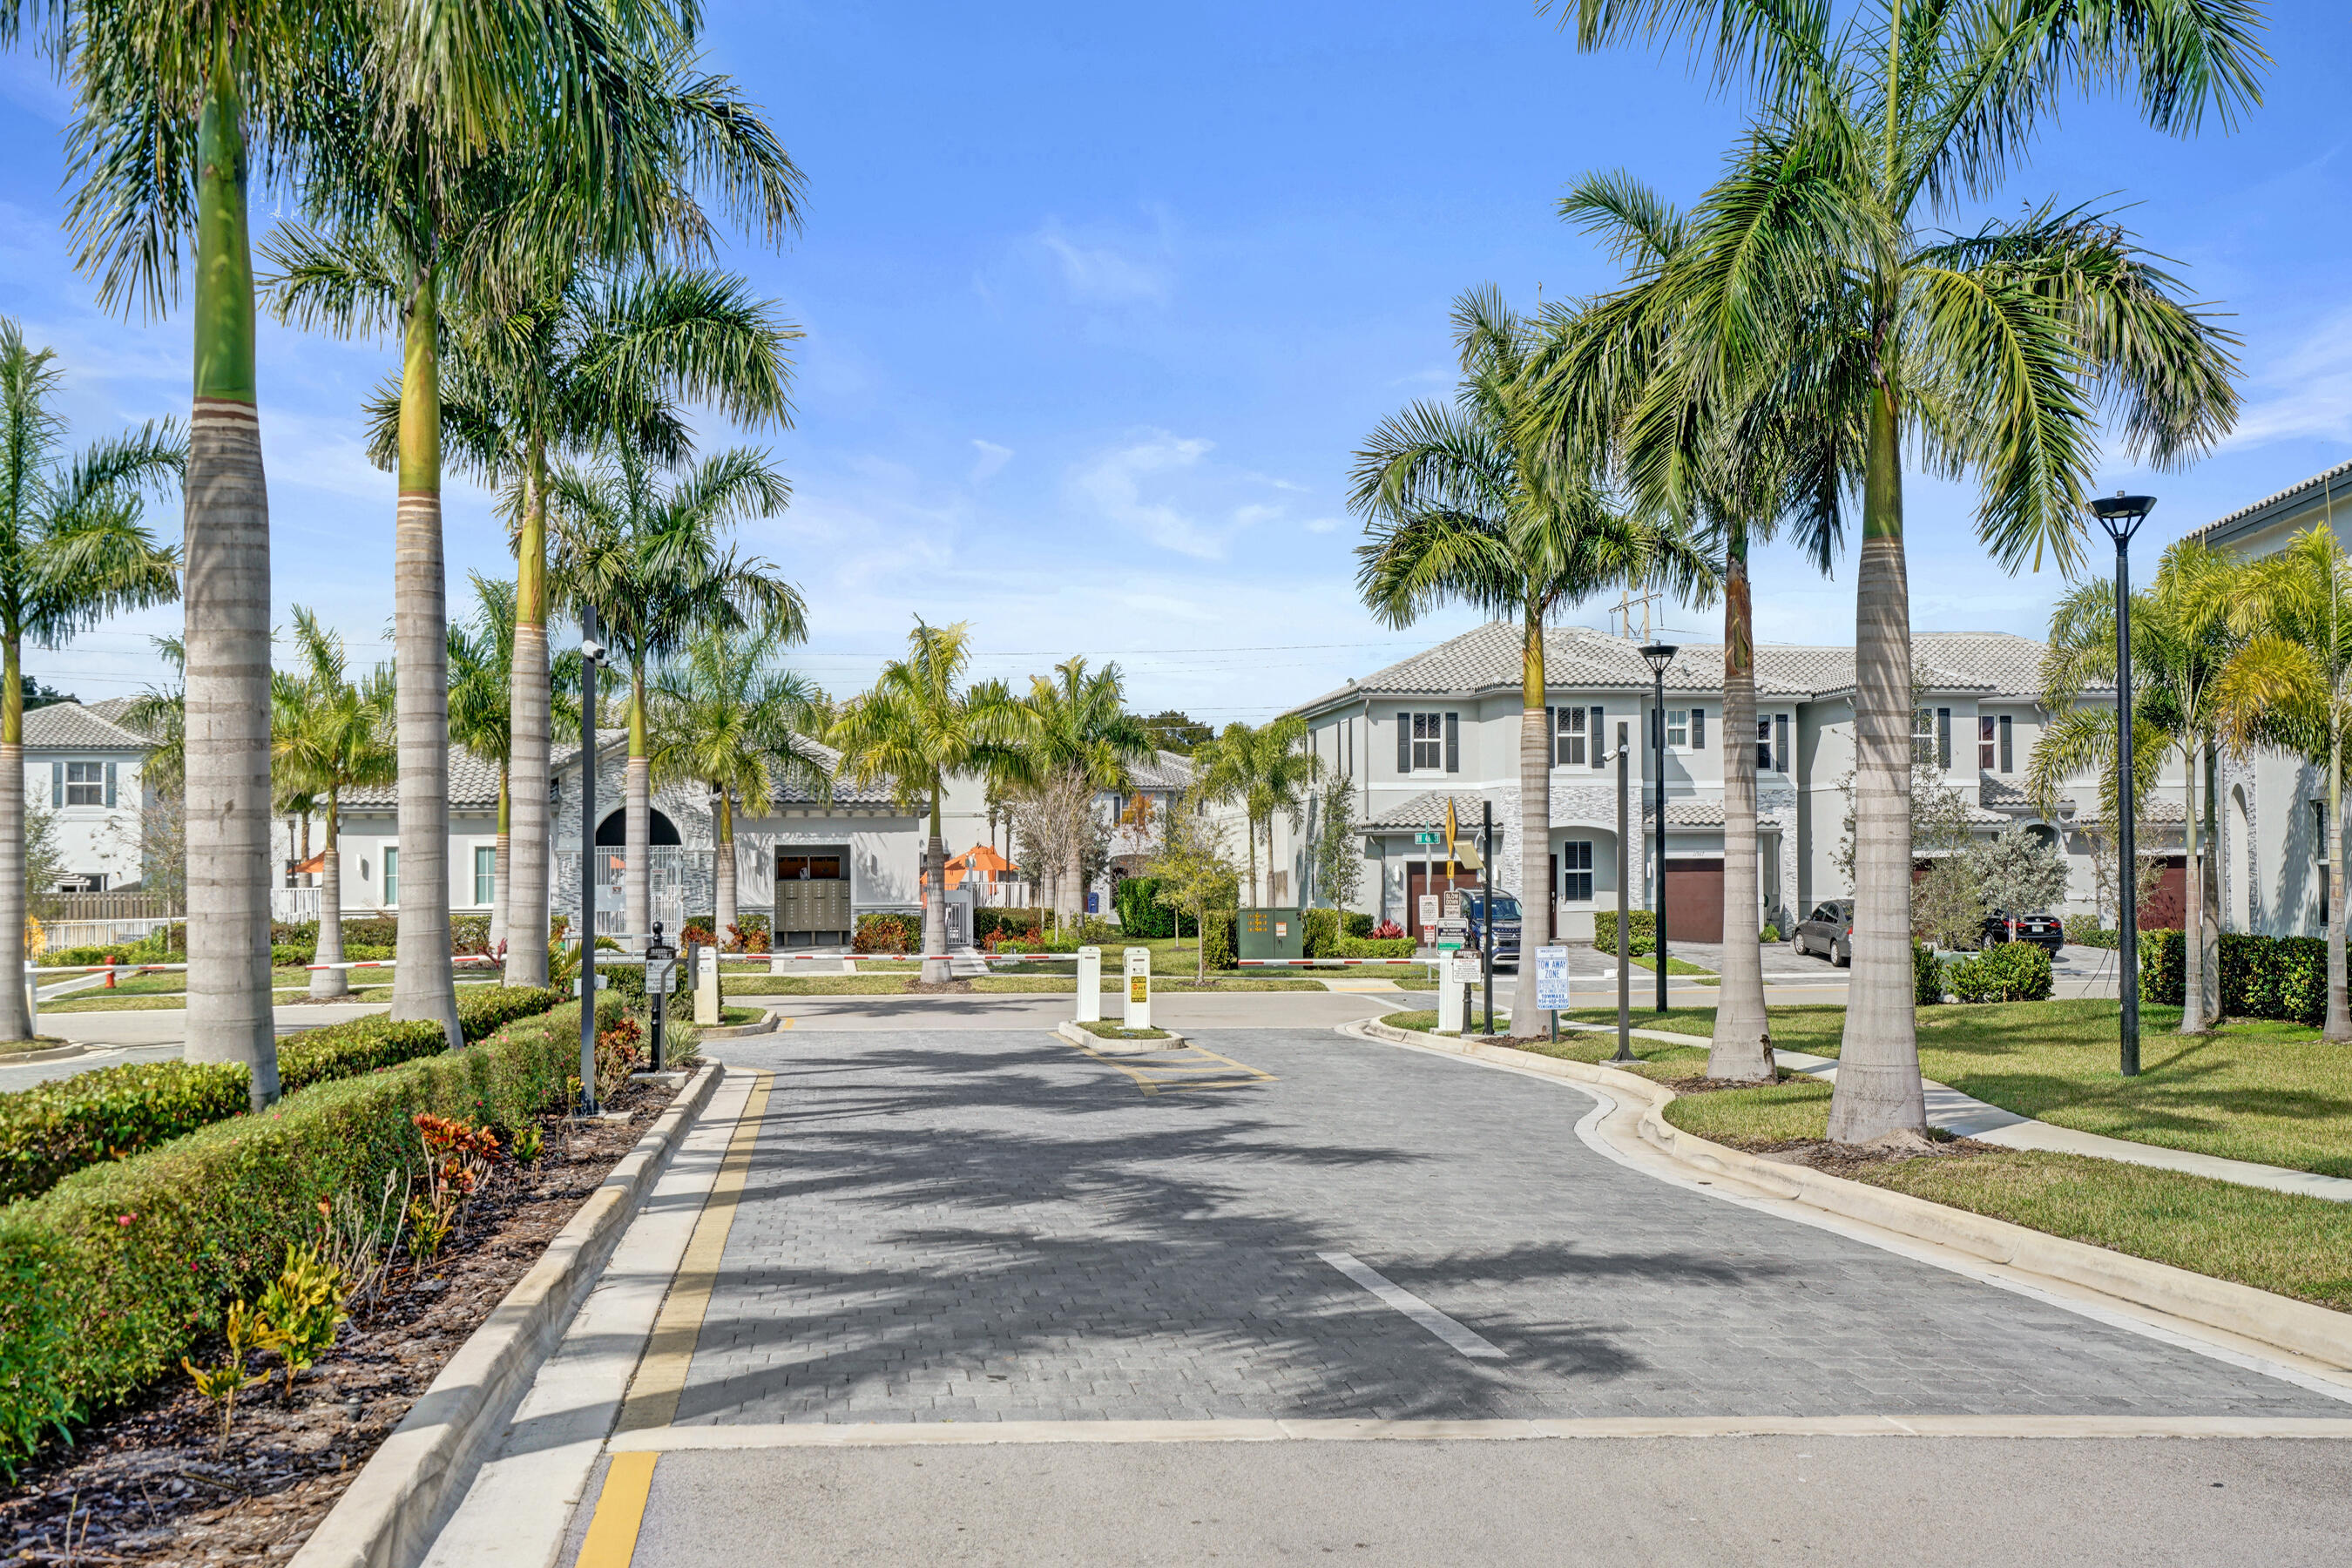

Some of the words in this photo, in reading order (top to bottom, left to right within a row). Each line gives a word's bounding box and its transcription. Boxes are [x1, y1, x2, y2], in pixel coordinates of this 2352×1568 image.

[1538, 960, 1550, 970] TOW
[1552, 960, 1566, 970] AWAY
[1545, 970, 1560, 979] ZONE
